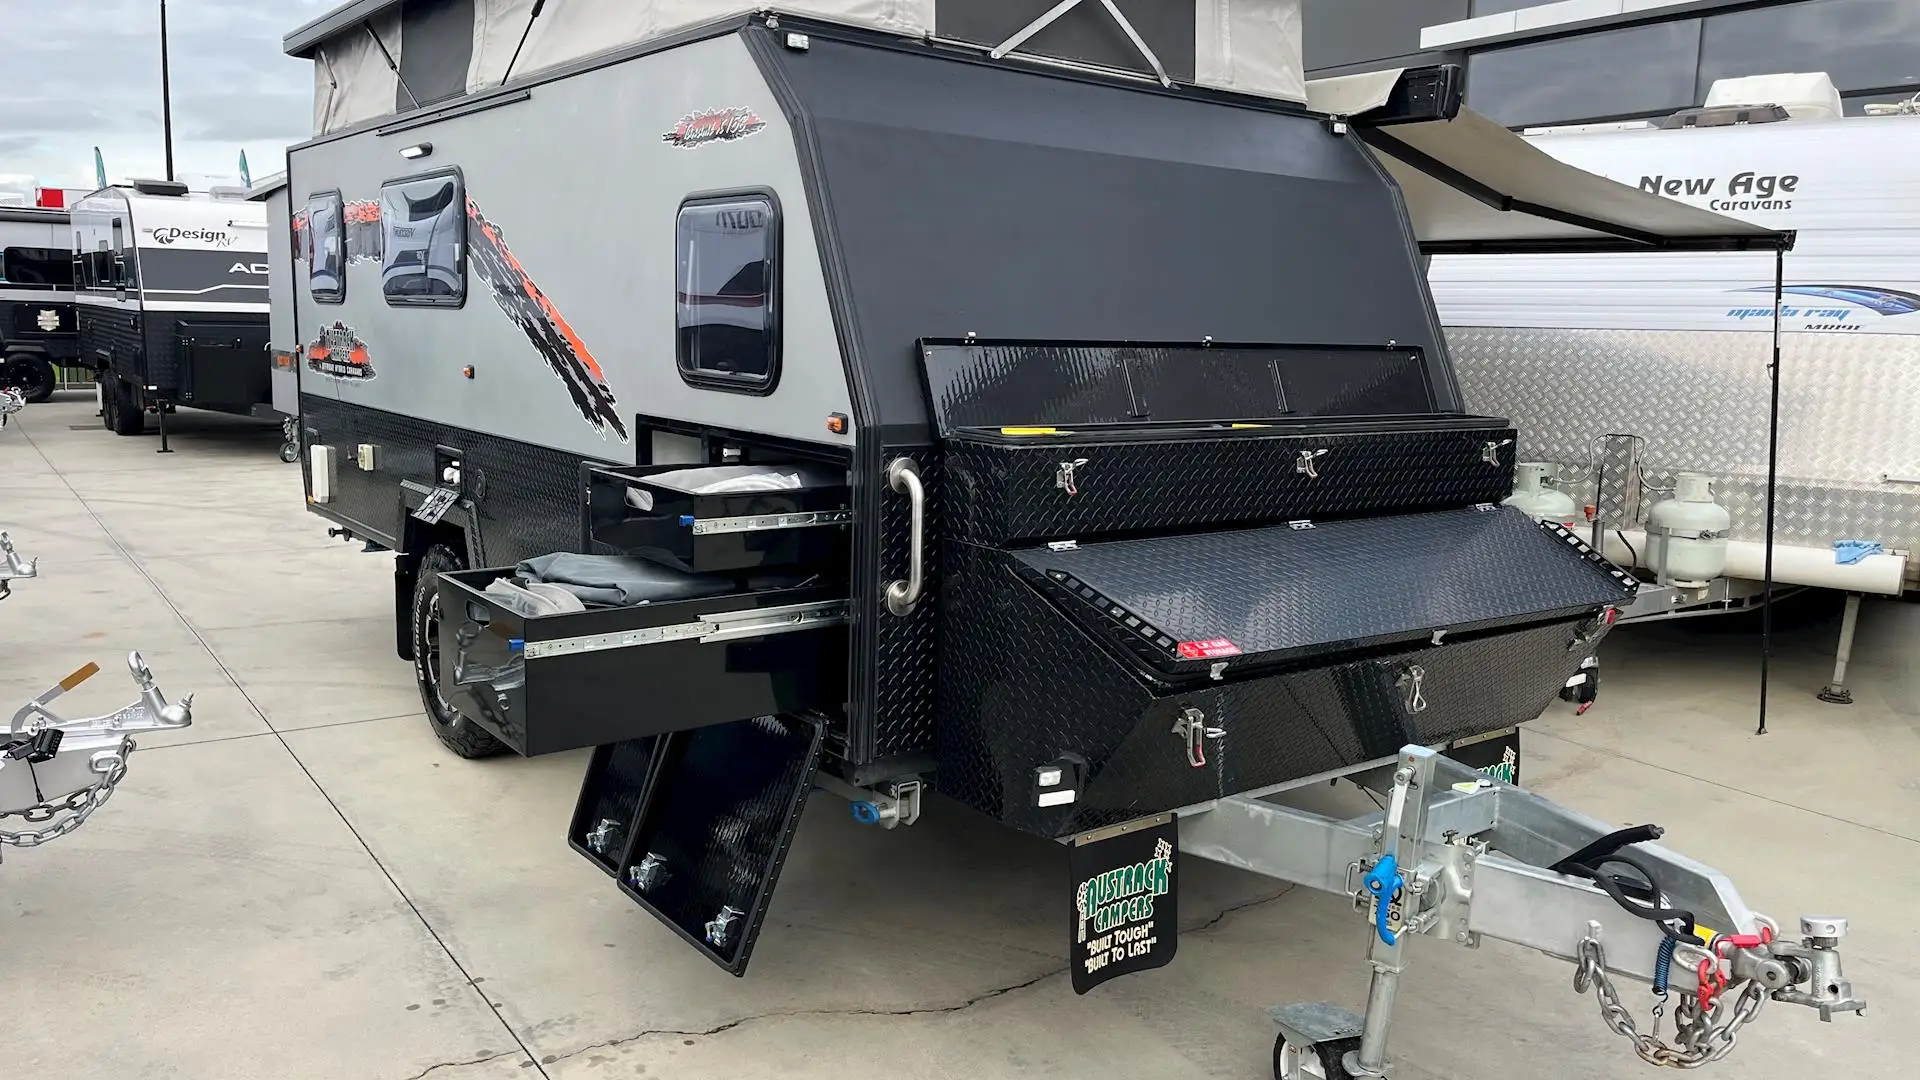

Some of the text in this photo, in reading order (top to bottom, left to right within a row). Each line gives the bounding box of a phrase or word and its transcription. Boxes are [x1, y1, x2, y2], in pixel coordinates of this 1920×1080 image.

[1639, 171, 1799, 199] New Age
[1709, 198, 1792, 212] Caravans
[169, 227, 226, 243] Design
[1804, 308, 1852, 322] ray
[1085, 857, 1169, 920] AUSTRACK
[1094, 893, 1154, 934] CAMPERS
[1111, 947, 1124, 964] TO
